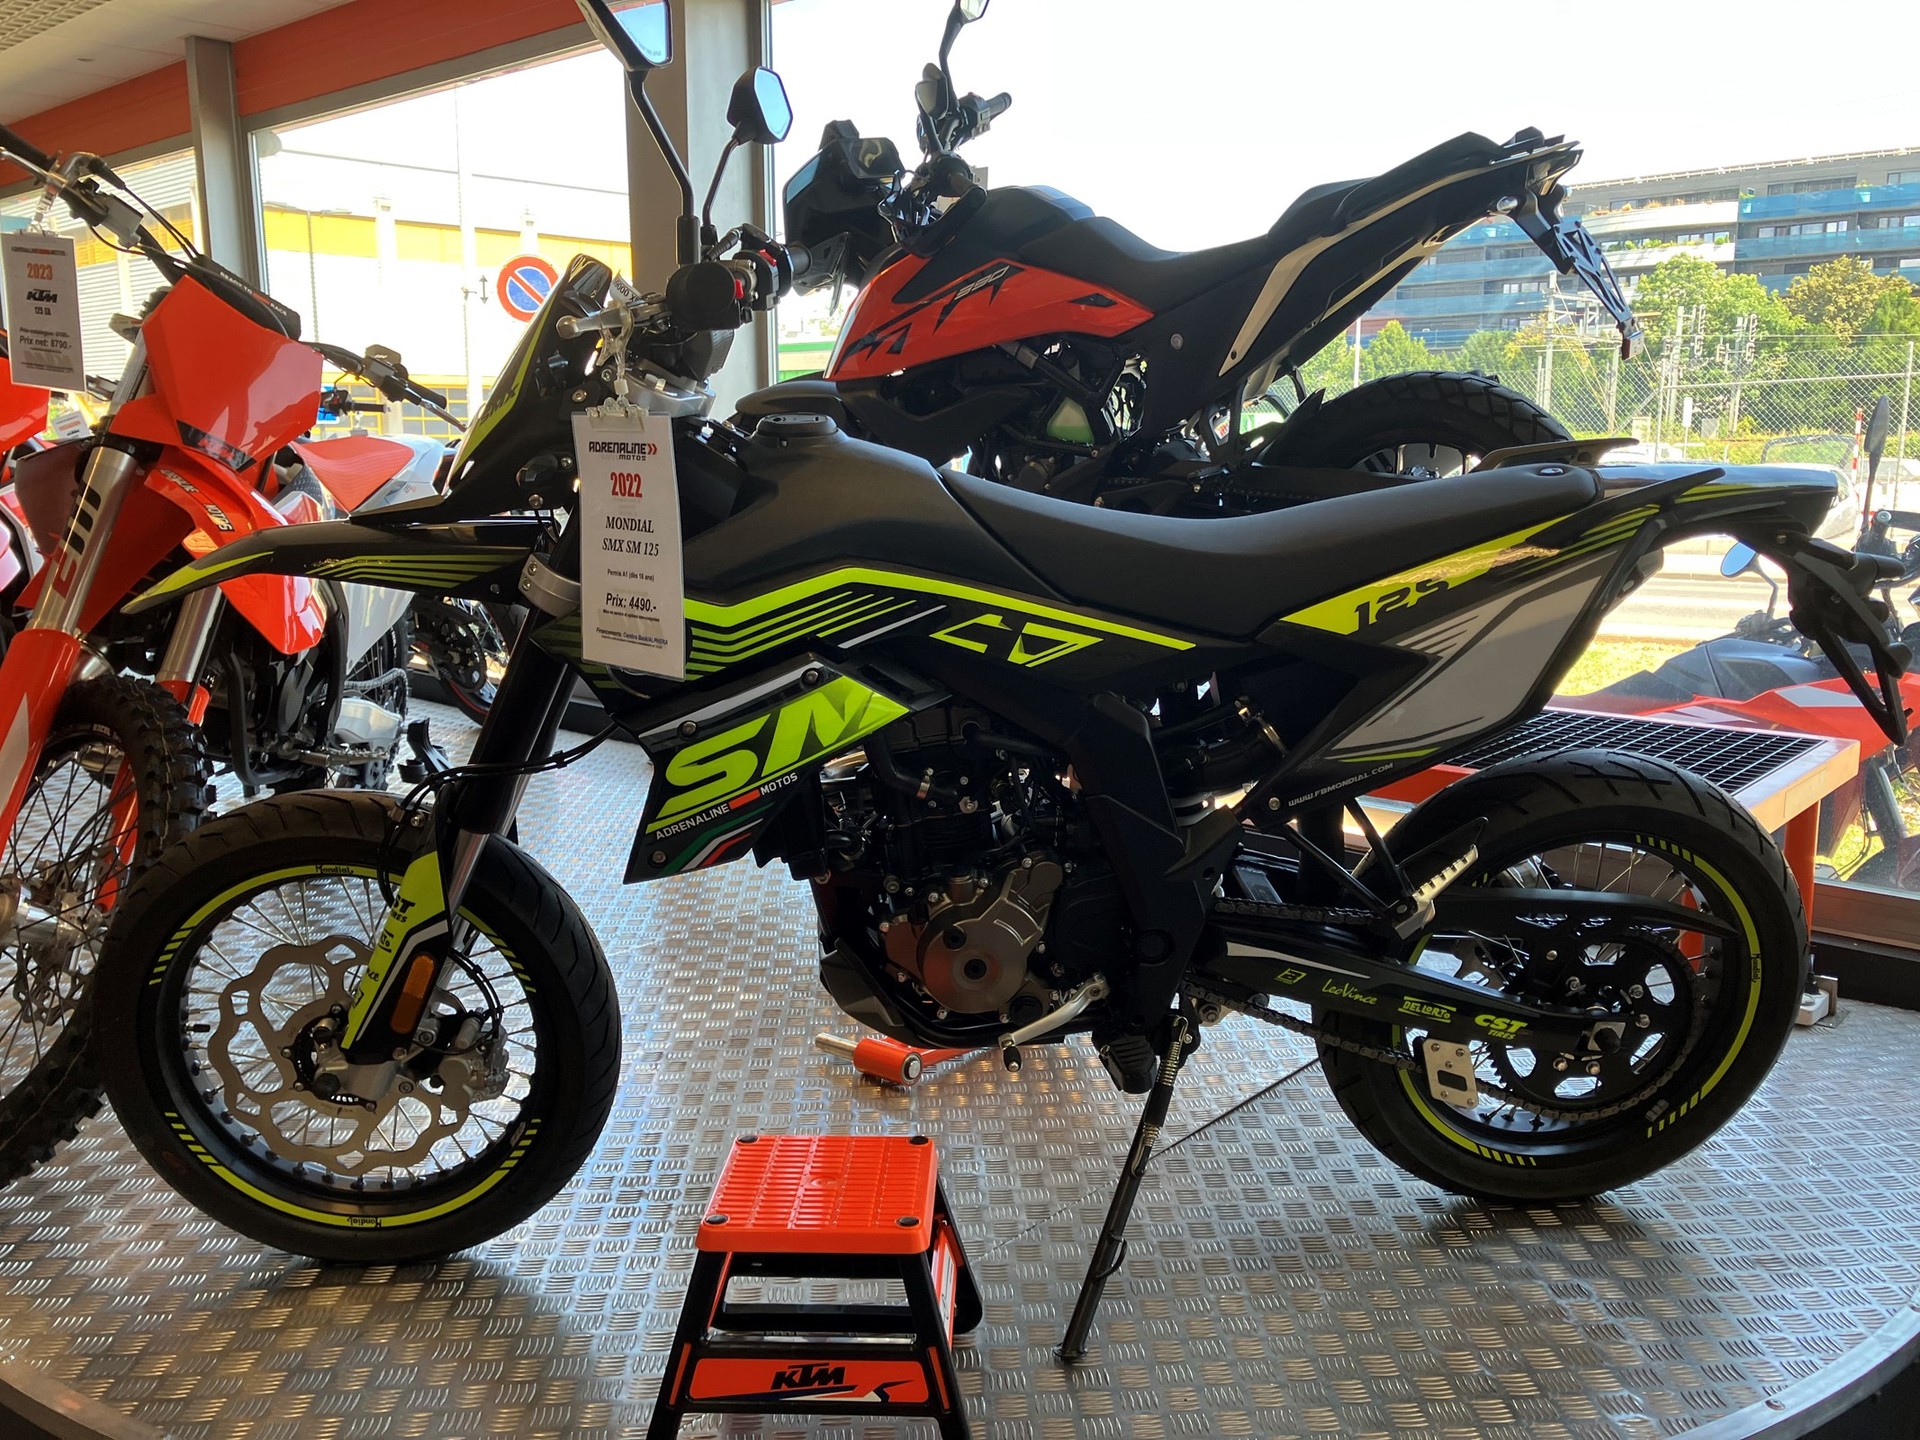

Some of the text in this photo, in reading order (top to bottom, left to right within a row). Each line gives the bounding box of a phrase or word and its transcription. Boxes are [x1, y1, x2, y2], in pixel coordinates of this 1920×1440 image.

[27, 262, 53, 281] 2023
[954, 265, 1010, 301] 390
[26, 288, 58, 304] KTM
[19, 335, 33, 345] Prix
[35, 339, 49, 347] net:
[588, 441, 647, 455] ADRENALINE
[619, 454, 647, 462] MOTOS
[610, 471, 643, 498] 2022
[605, 516, 655, 534] MONDIAL
[602, 537, 660, 557] SMX SM 125
[607, 568, 622, 577] Permis
[605, 592, 657, 613] Prix: 4490.-
[1354, 579, 1450, 632] 125
[1288, 762, 1395, 808] WWW.FBMONDIAL.COM
[655, 772, 799, 841] ADRENALINE MOTOS
[392, 894, 416, 914] ST
[1322, 978, 1378, 1005] LeoVince
[1474, 1014, 1528, 1033] CST
[1487, 1029, 1517, 1040] TIRES
[770, 1361, 846, 1390] KTM
